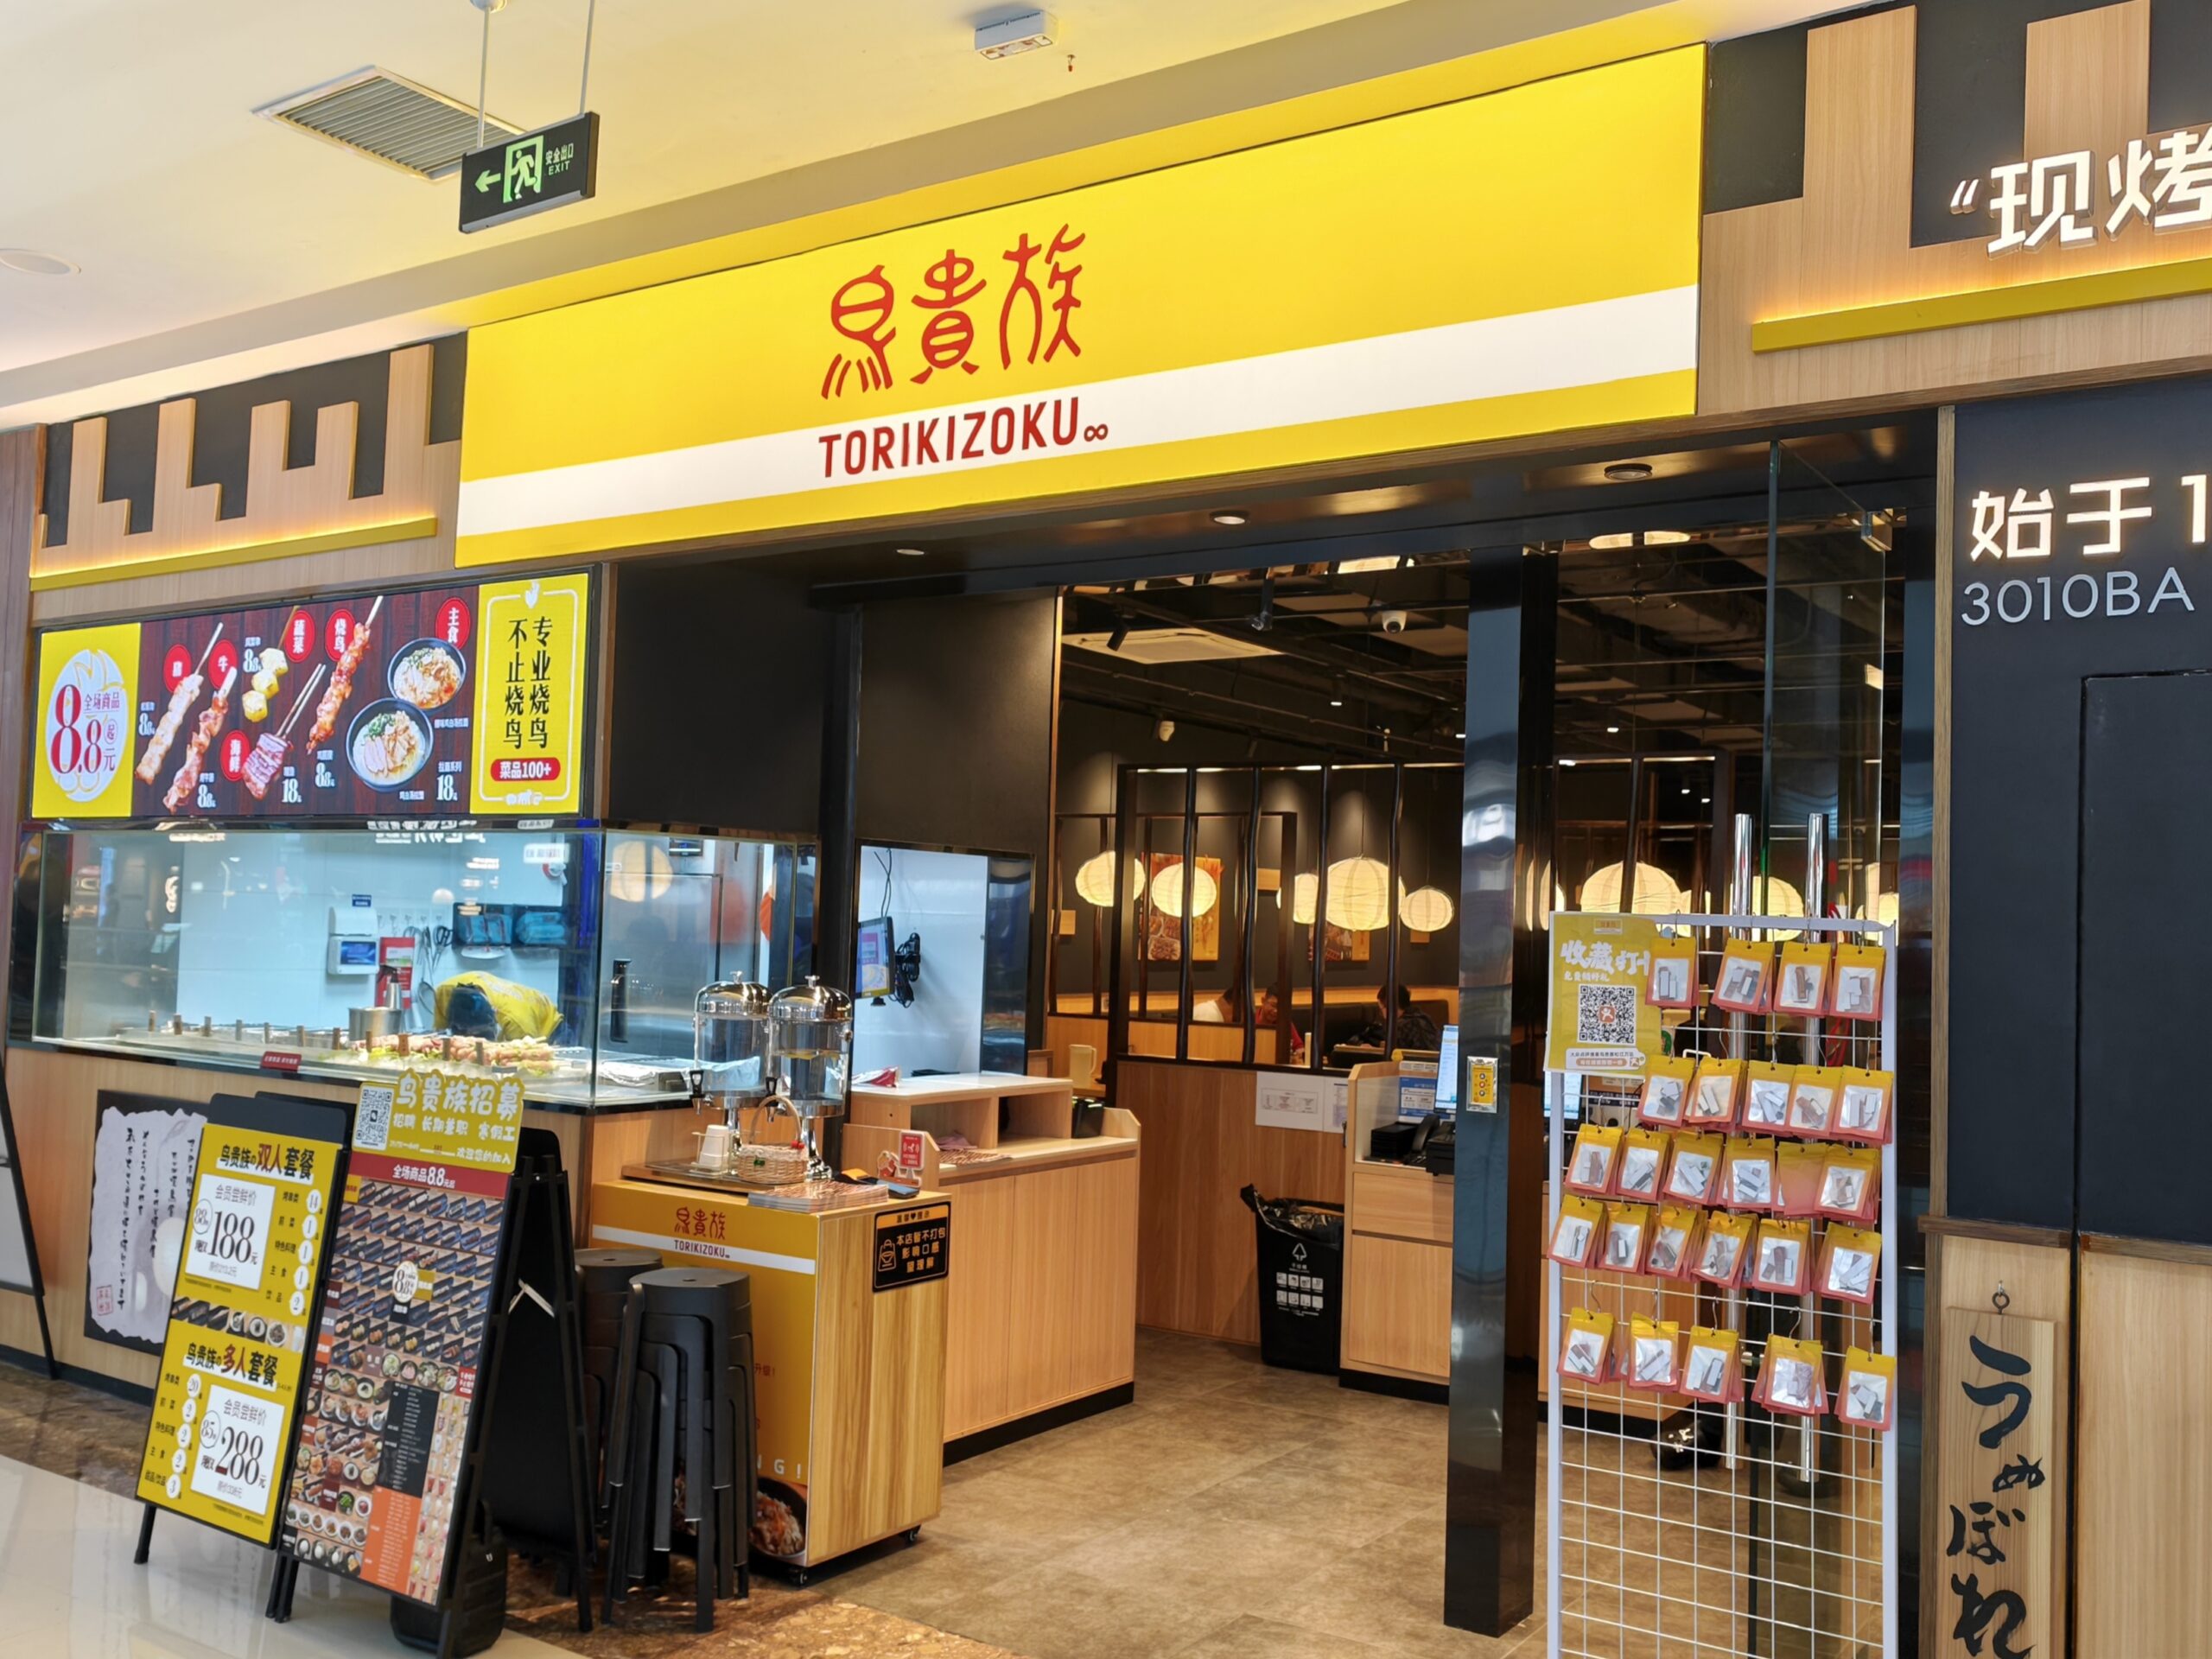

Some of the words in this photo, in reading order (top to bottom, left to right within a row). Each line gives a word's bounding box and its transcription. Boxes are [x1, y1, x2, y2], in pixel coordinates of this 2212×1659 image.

[545, 143, 574, 165] 安全出口
[548, 161, 570, 176] EXIT
[818, 397, 1079, 478] TORIKIZOKU
[1961, 567, 2195, 626] 3010BA
[448, 607, 460, 643] 主食
[218, 656, 228, 672] 牛
[503, 618, 527, 749] 不止烧鸟
[528, 616, 553, 748] 专业烧鸟
[84, 692, 120, 711] 全场商品
[499, 760, 552, 779] 菜品100+
[396, 1075, 519, 1122] 鸟贵族招募
[393, 1113, 416, 1129] 招聘
[422, 1115, 469, 1136] 长期兼职
[479, 1122, 515, 1141] 寒假工
[456, 1147, 511, 1165] 欢迎您的加入
[897, 1227, 946, 1246] 本店暂不打包
[674, 1239, 726, 1258] TORIKIZOKU
[902, 1241, 939, 1259] 影响口感
